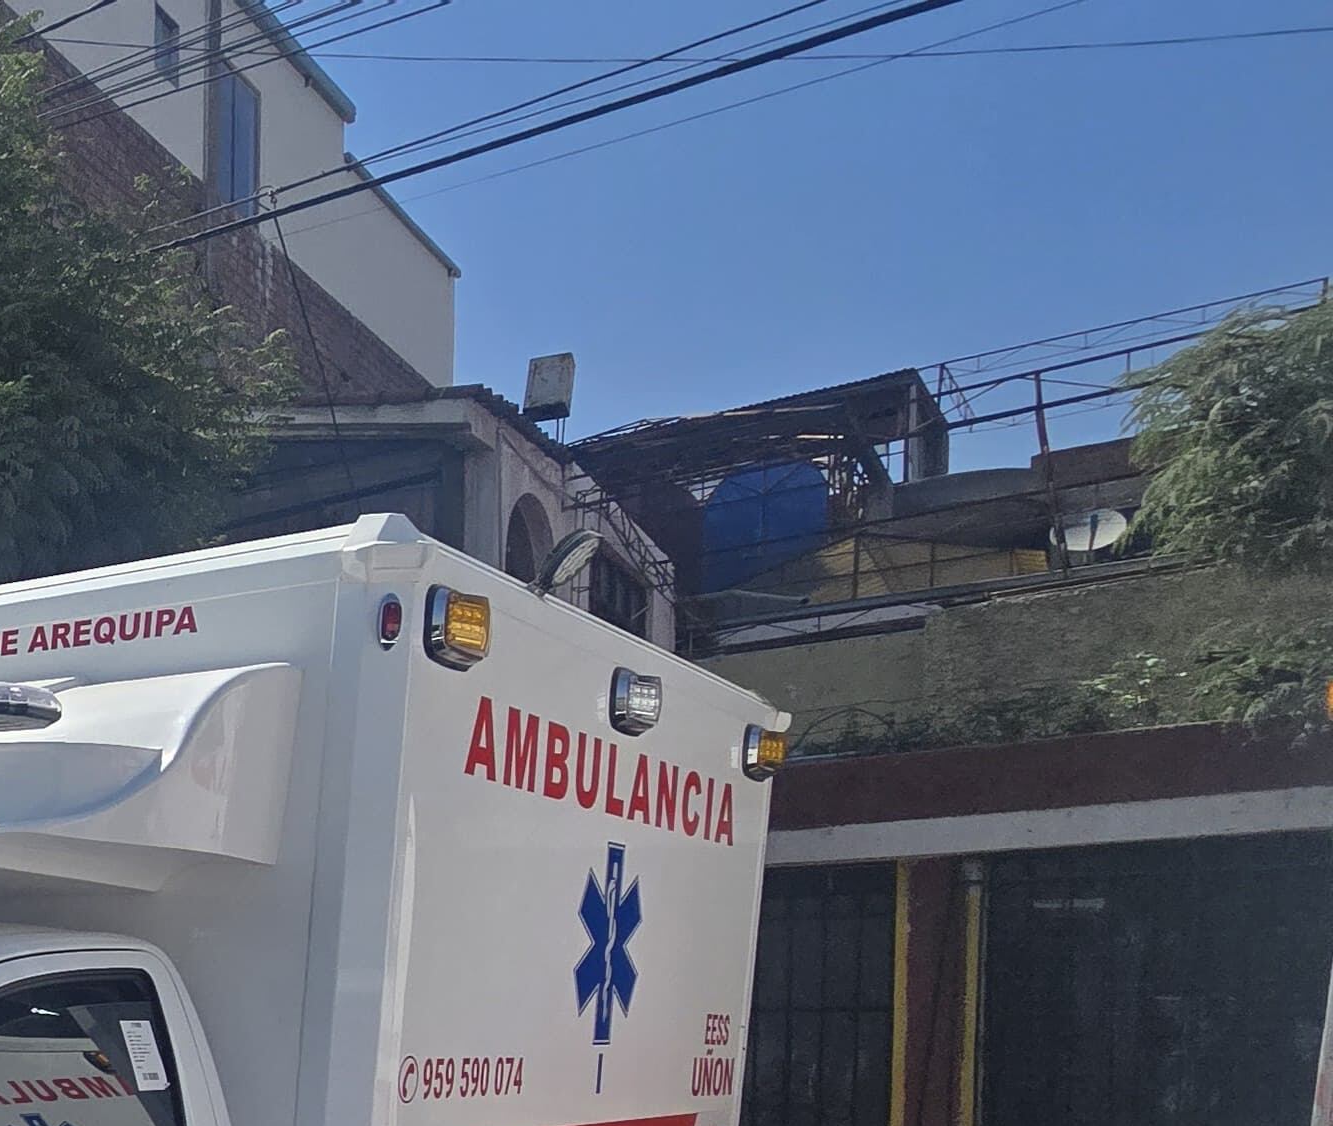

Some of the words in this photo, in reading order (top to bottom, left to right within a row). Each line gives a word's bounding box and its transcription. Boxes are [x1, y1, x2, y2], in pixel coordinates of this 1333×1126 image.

[27, 606, 198, 653] AREQUIPA
[464, 695, 734, 846] AMBULANCIA
[704, 1013, 731, 1046] EESS
[423, 1058, 455, 1100] 959
[459, 1057, 490, 1098] 590
[494, 1057, 525, 1096] 074
[691, 1048, 735, 1097] UÑON
